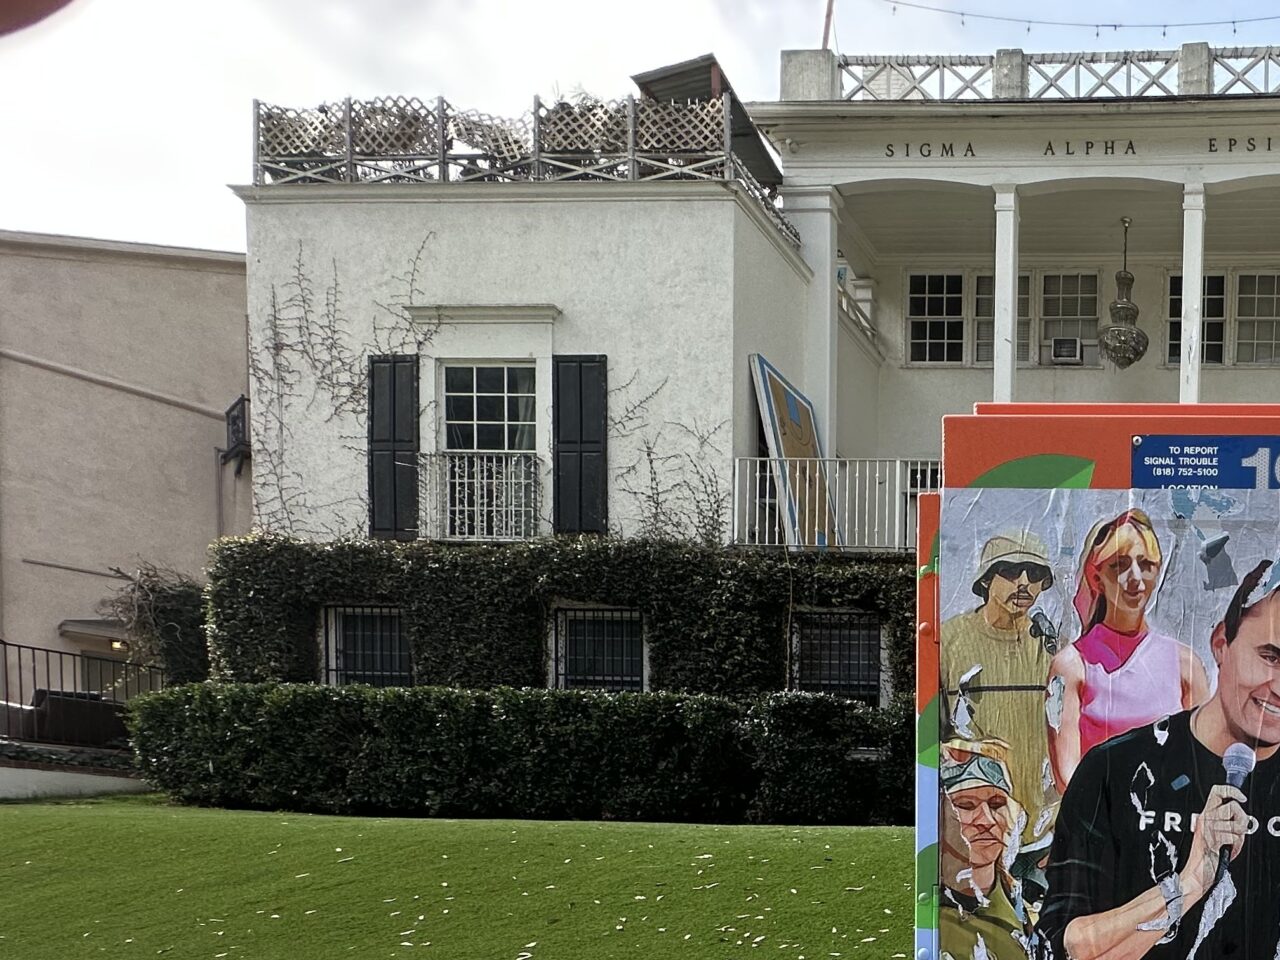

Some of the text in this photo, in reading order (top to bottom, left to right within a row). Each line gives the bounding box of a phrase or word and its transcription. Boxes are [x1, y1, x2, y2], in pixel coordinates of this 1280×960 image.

[885, 142, 977, 158] SIGMA
[1043, 138, 1138, 156] ALPHA
[1168, 446, 1219, 455] TO REPORT
[1143, 456, 1219, 466] SIGNAL TROUBLE
[1152, 467, 1219, 477] (818) 752-5100
